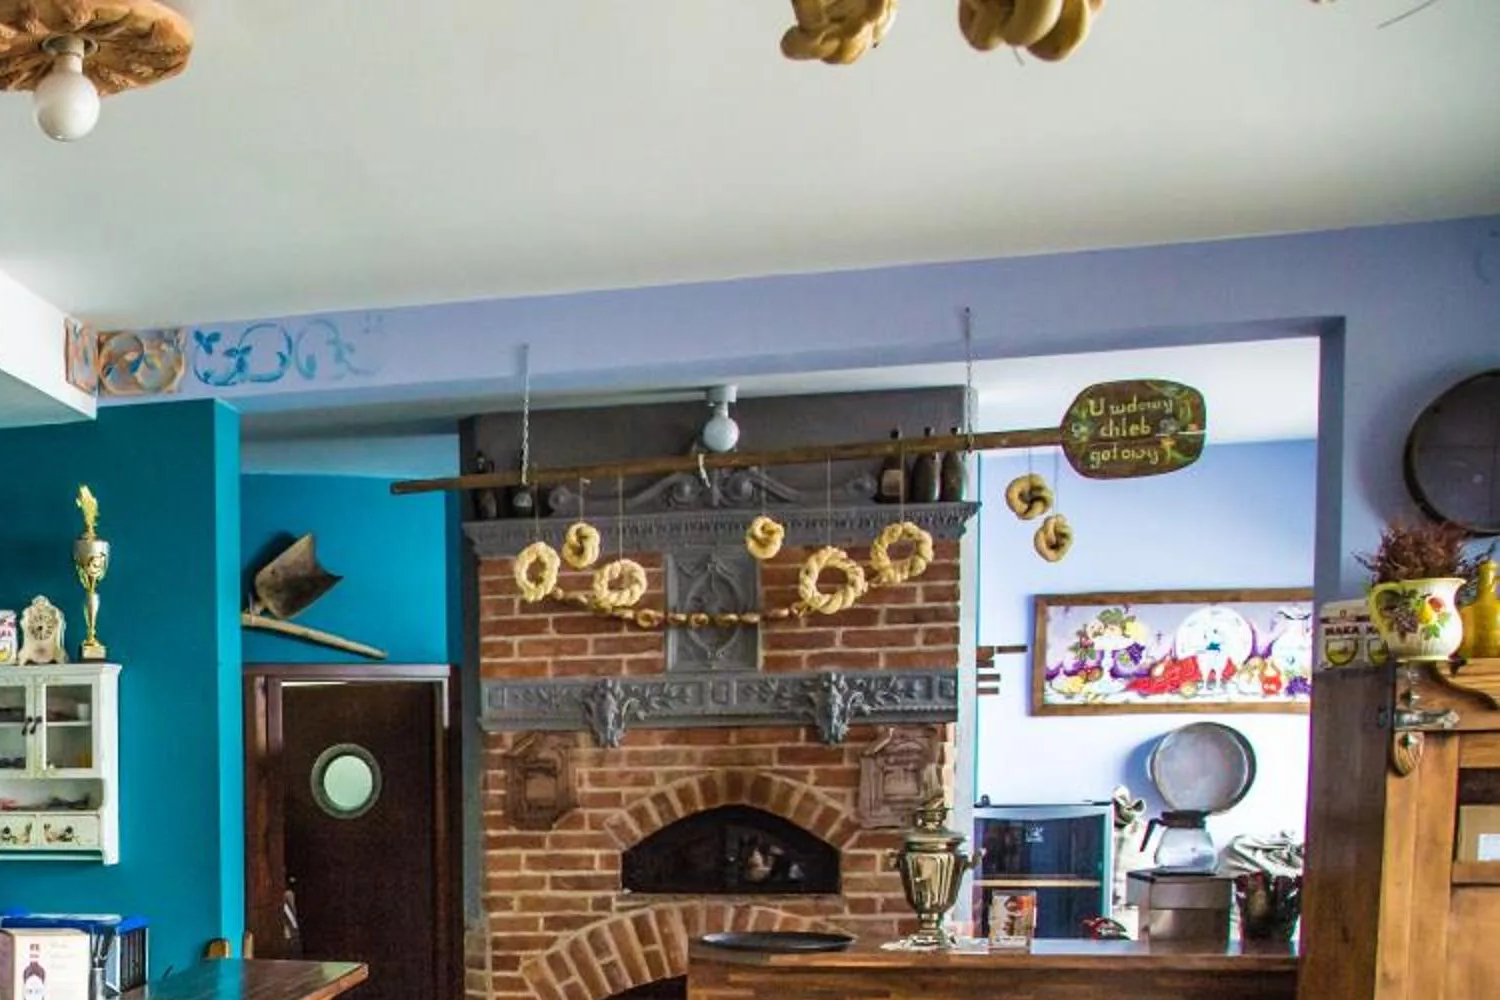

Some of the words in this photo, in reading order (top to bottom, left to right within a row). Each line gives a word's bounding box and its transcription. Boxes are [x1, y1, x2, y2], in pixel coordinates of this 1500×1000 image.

[1088, 397, 1105, 416] U
[1099, 416, 1152, 437] chleb
[1089, 442, 1160, 469] gotowy
